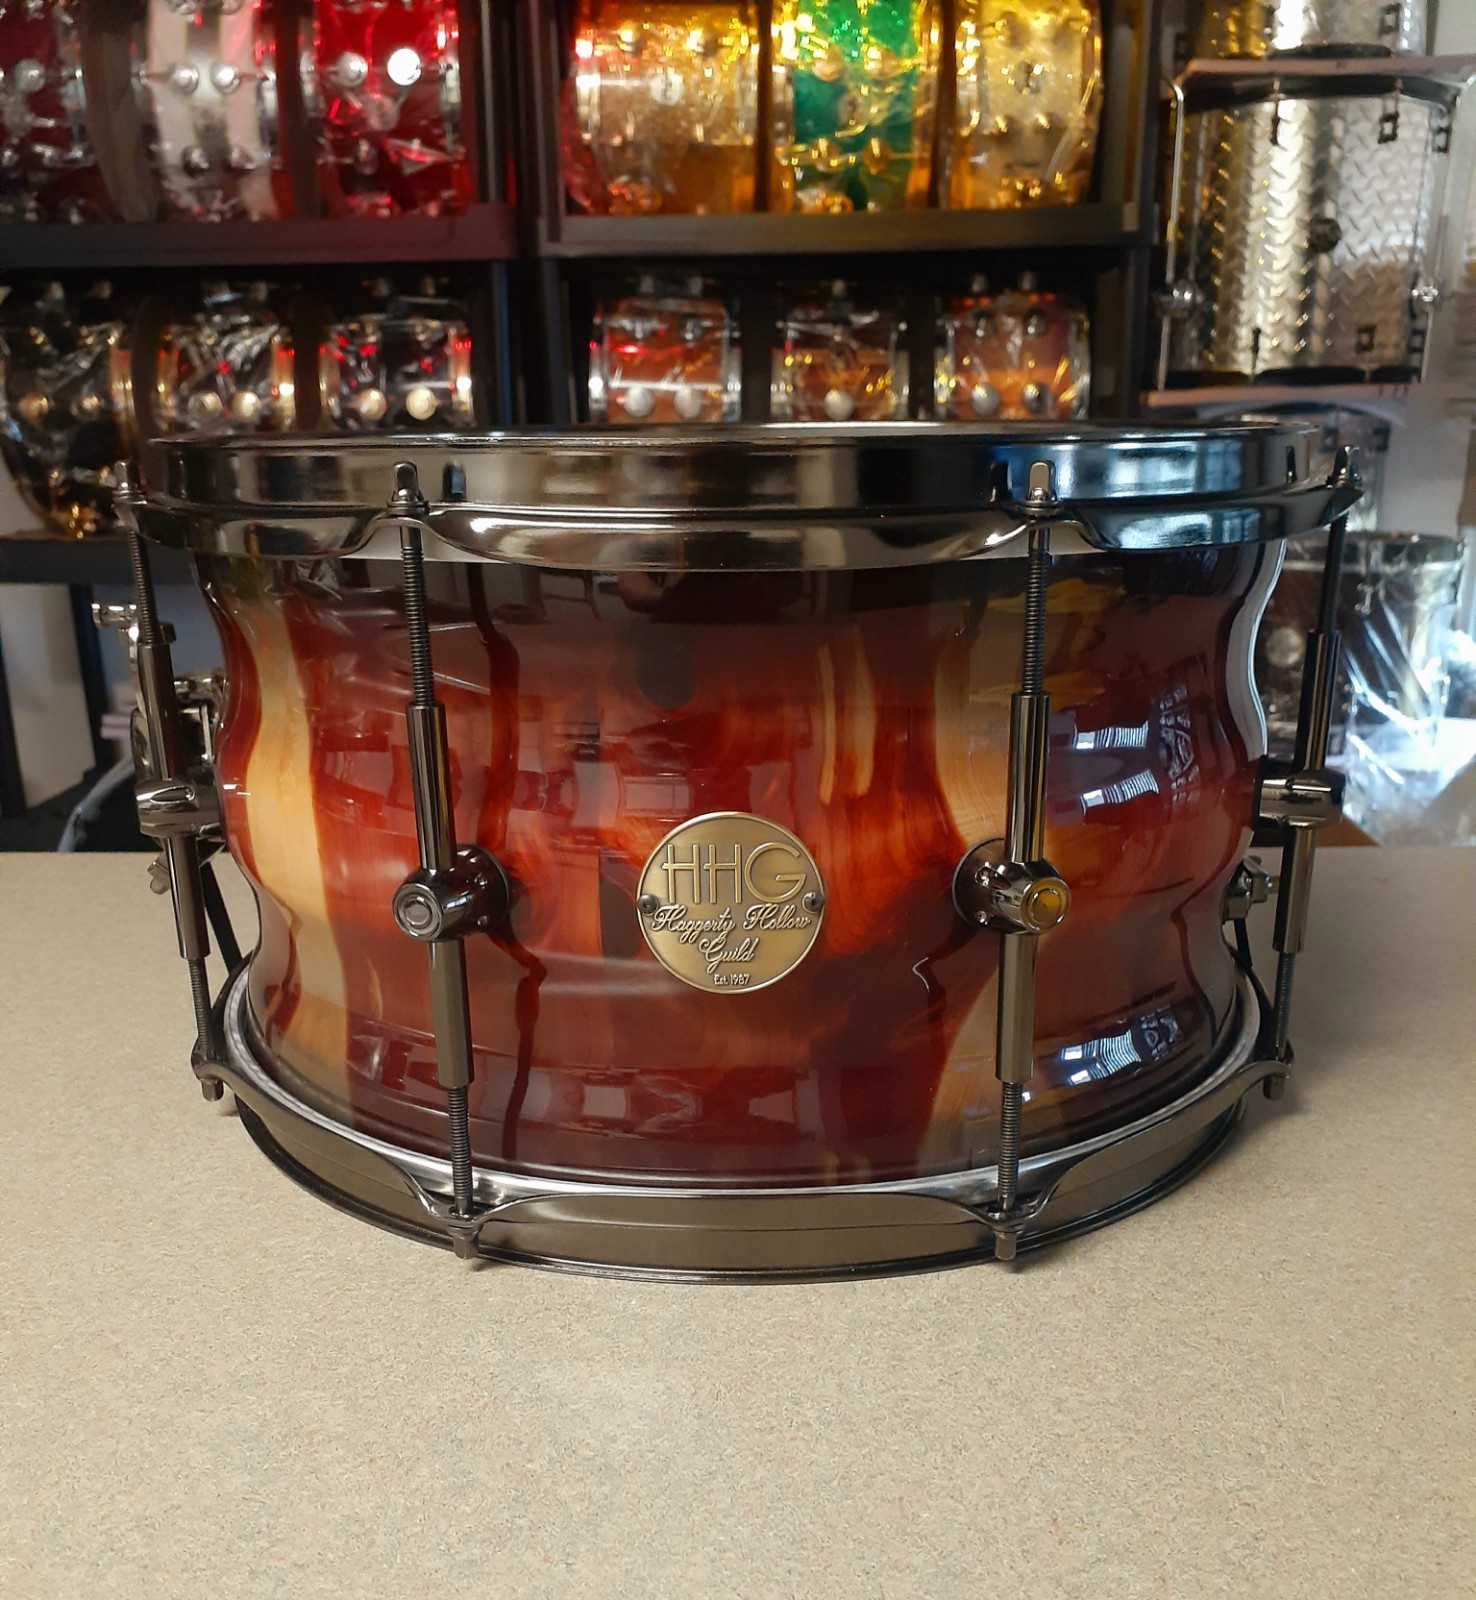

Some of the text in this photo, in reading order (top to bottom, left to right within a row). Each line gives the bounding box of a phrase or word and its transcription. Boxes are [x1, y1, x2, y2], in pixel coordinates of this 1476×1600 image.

[662, 842, 806, 904] HHG
[651, 903, 811, 944] Haggerty Hollow
[699, 937, 760, 974] Guild
[730, 973, 750, 985] 1987
